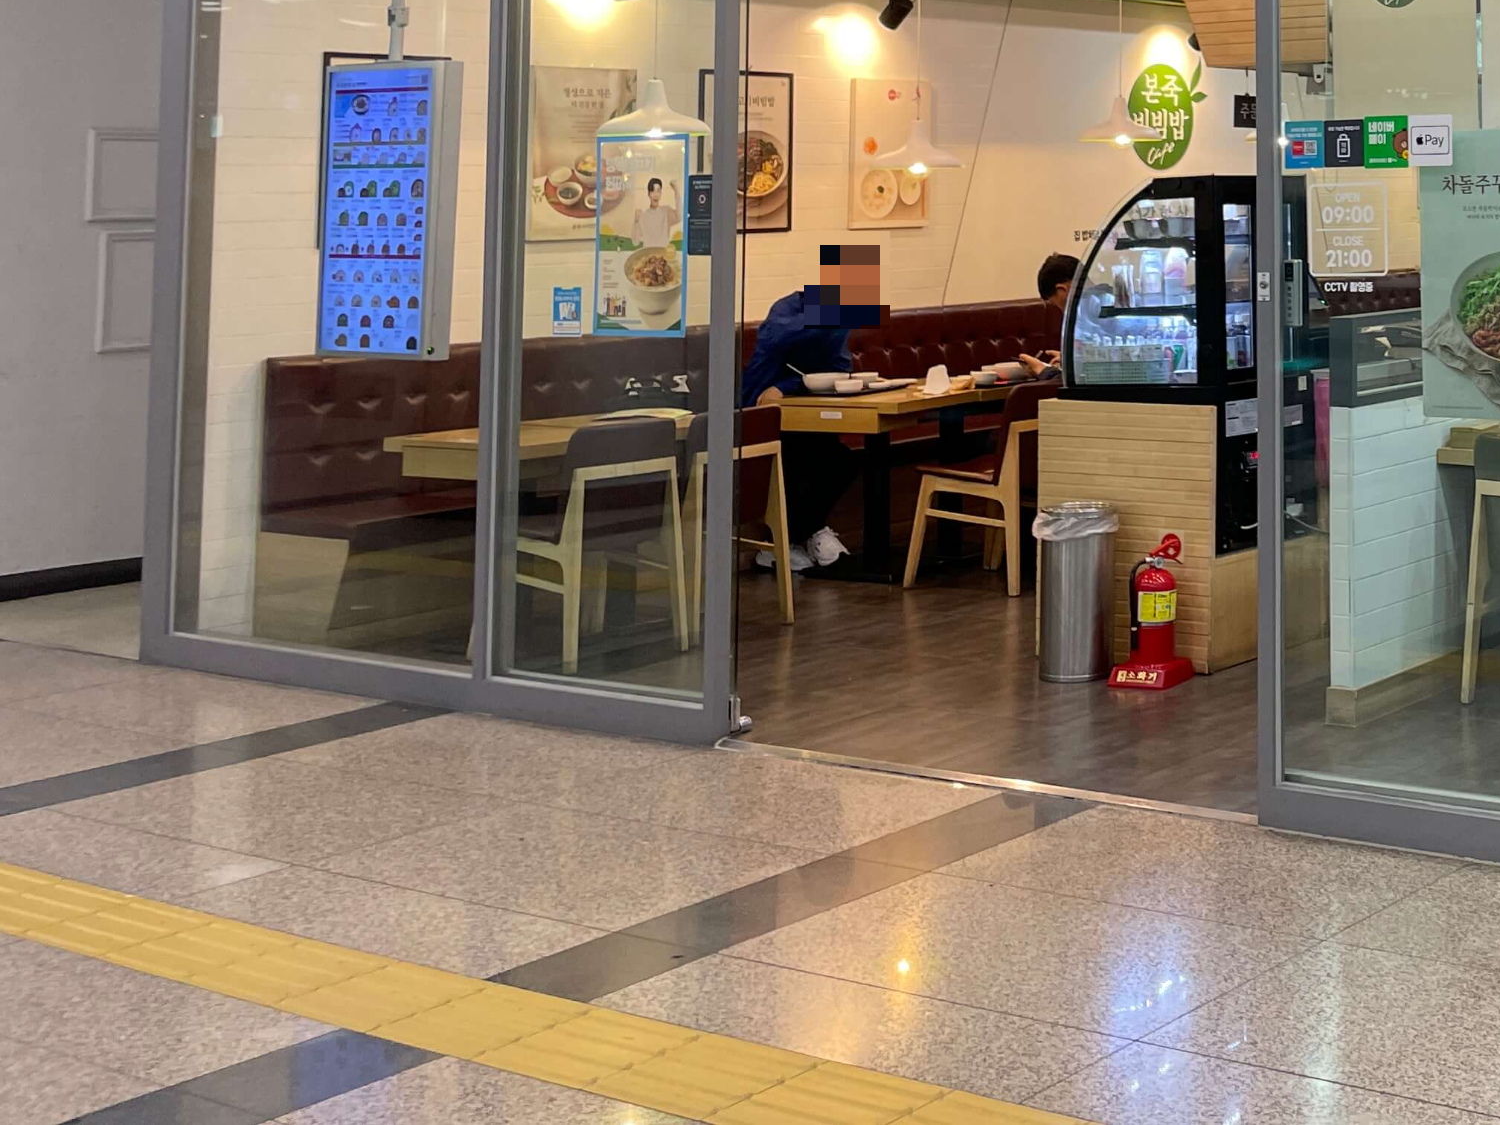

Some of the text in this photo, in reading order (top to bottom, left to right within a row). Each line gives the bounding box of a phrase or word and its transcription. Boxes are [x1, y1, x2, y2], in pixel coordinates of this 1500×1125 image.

[1141, 73, 1183, 106] 본죽
[1133, 108, 1189, 141] 비빔밥
[1425, 134, 1444, 148] Pay
[1335, 193, 1361, 203] OPEN
[1322, 205, 1374, 223] 09:00
[1333, 236, 1364, 246] CLOSE
[1326, 249, 1372, 268] 21:00
[1324, 282, 1348, 292] CCTV
